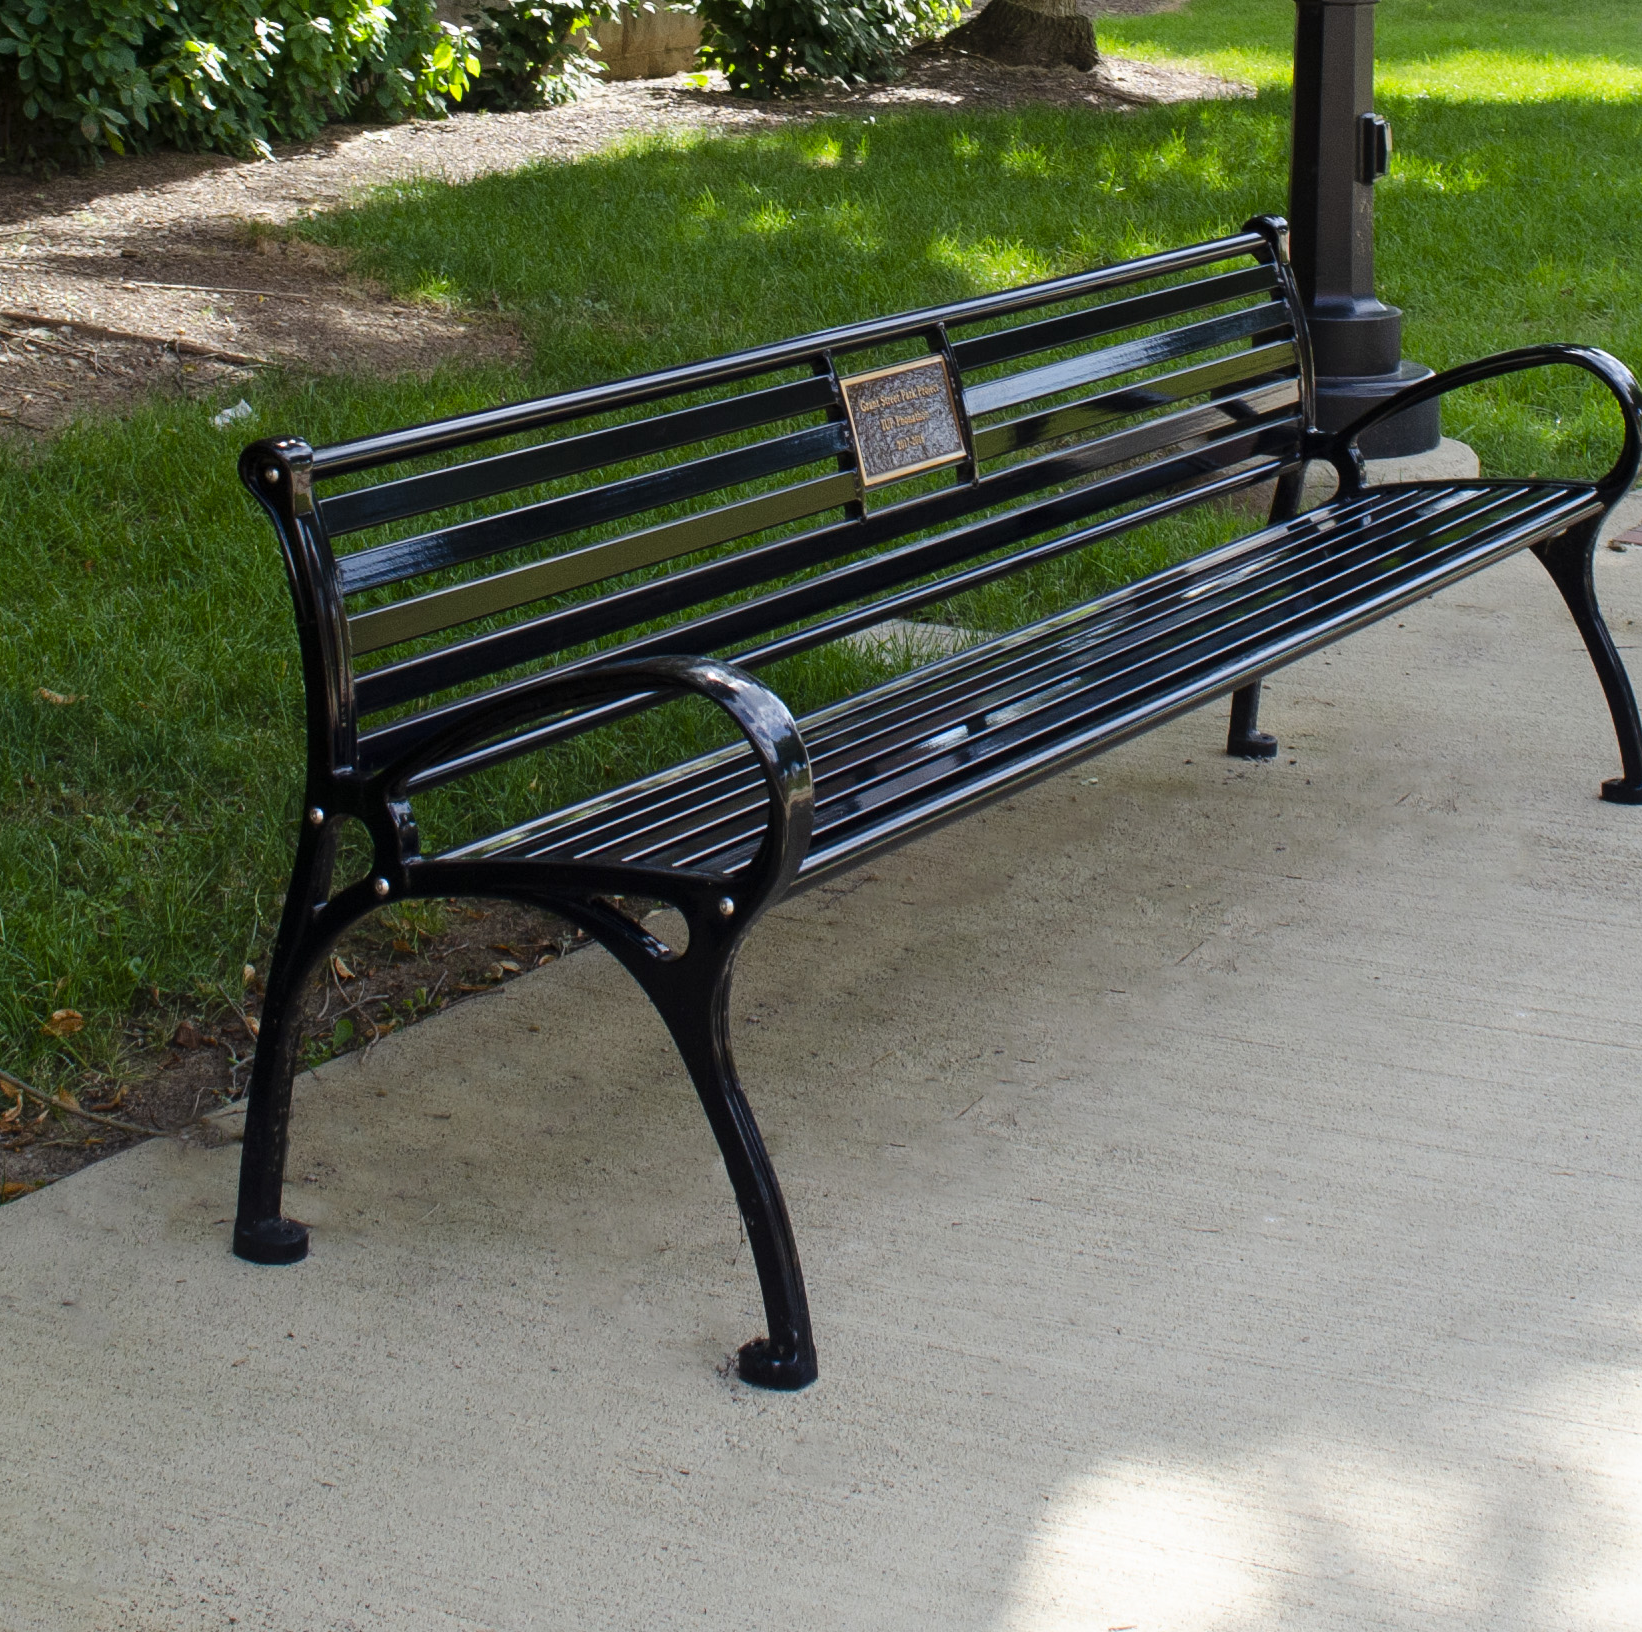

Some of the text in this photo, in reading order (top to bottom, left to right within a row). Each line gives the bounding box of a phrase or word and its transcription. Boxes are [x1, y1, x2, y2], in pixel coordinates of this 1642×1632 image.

[859, 383, 940, 413] Grant Street Park Project
[880, 417, 895, 432] IUP
